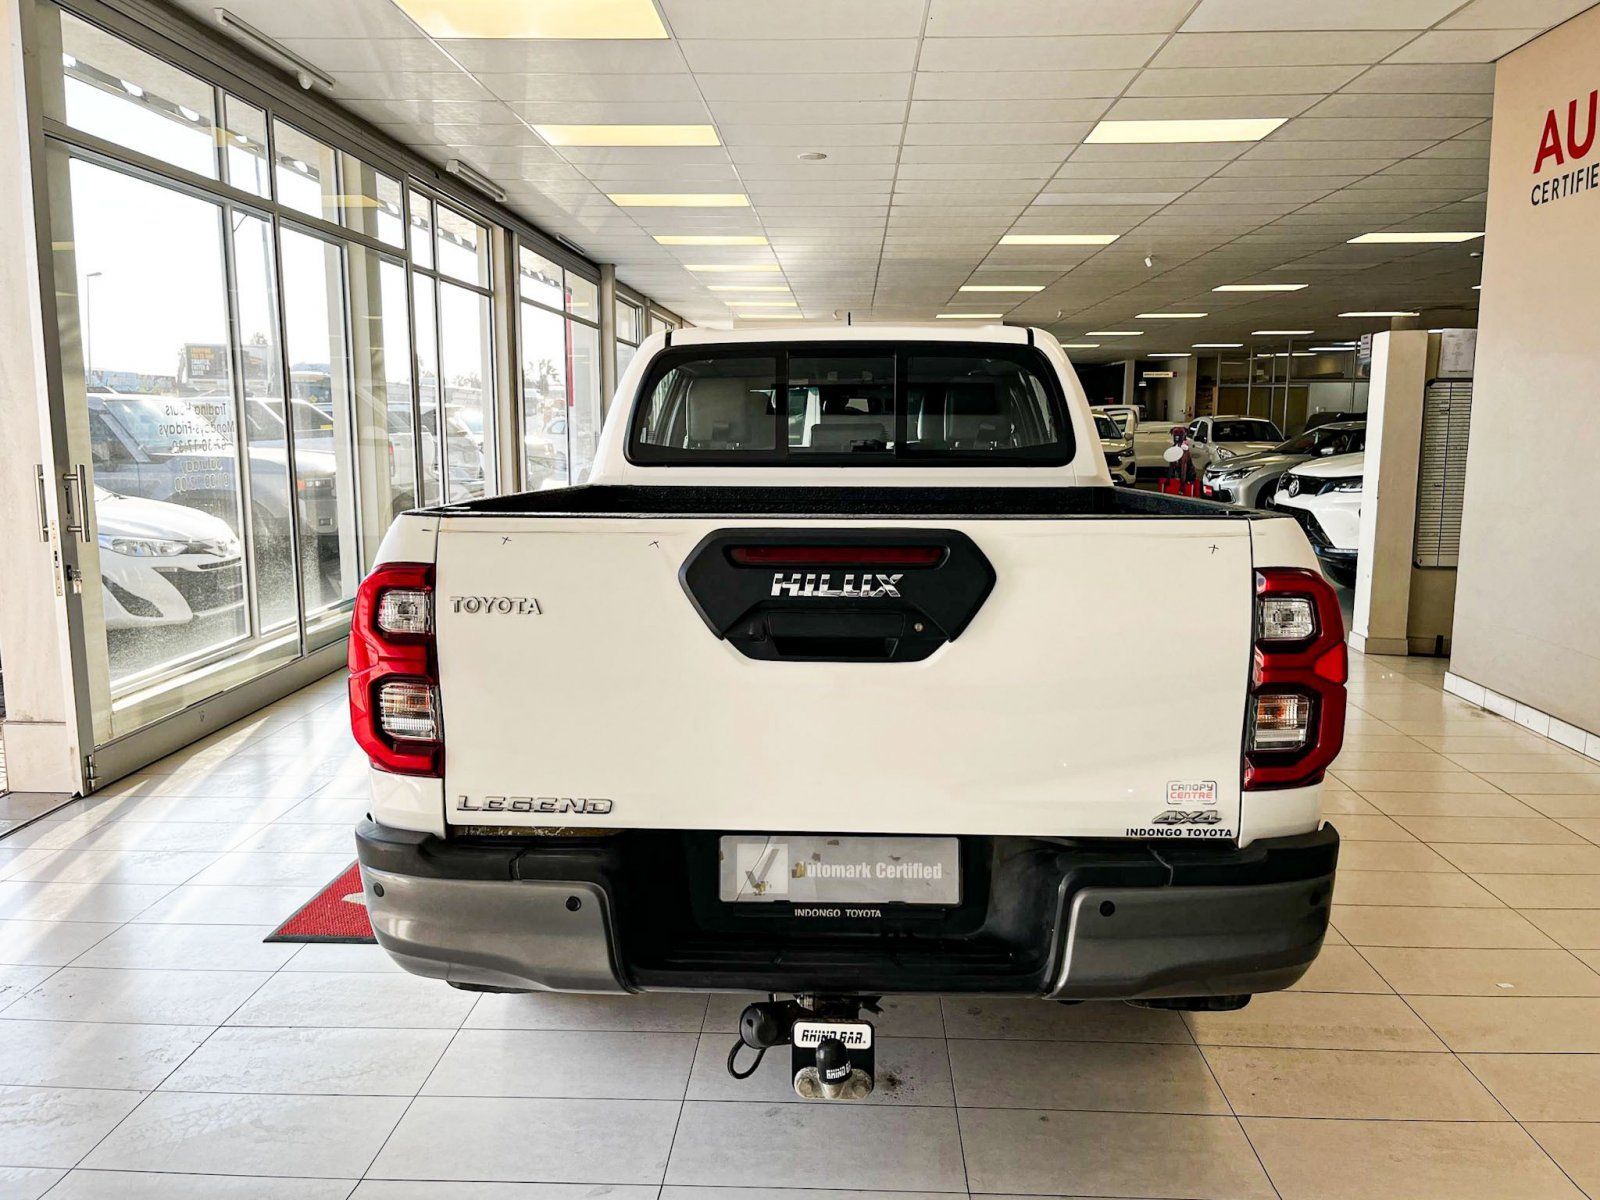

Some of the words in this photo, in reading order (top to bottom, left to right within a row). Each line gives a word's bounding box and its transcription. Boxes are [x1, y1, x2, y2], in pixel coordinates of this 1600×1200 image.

[771, 573, 904, 597] HILUX
[450, 596, 543, 615] TOYOTA
[457, 795, 613, 814] LEGEND
[1126, 828, 1182, 836] INDONGO
[1187, 828, 1232, 837] TOYOTA
[797, 861, 871, 878] utomark
[876, 862, 942, 879] Certified
[794, 908, 841, 917] INDONGO
[845, 909, 882, 917] TOYOTA
